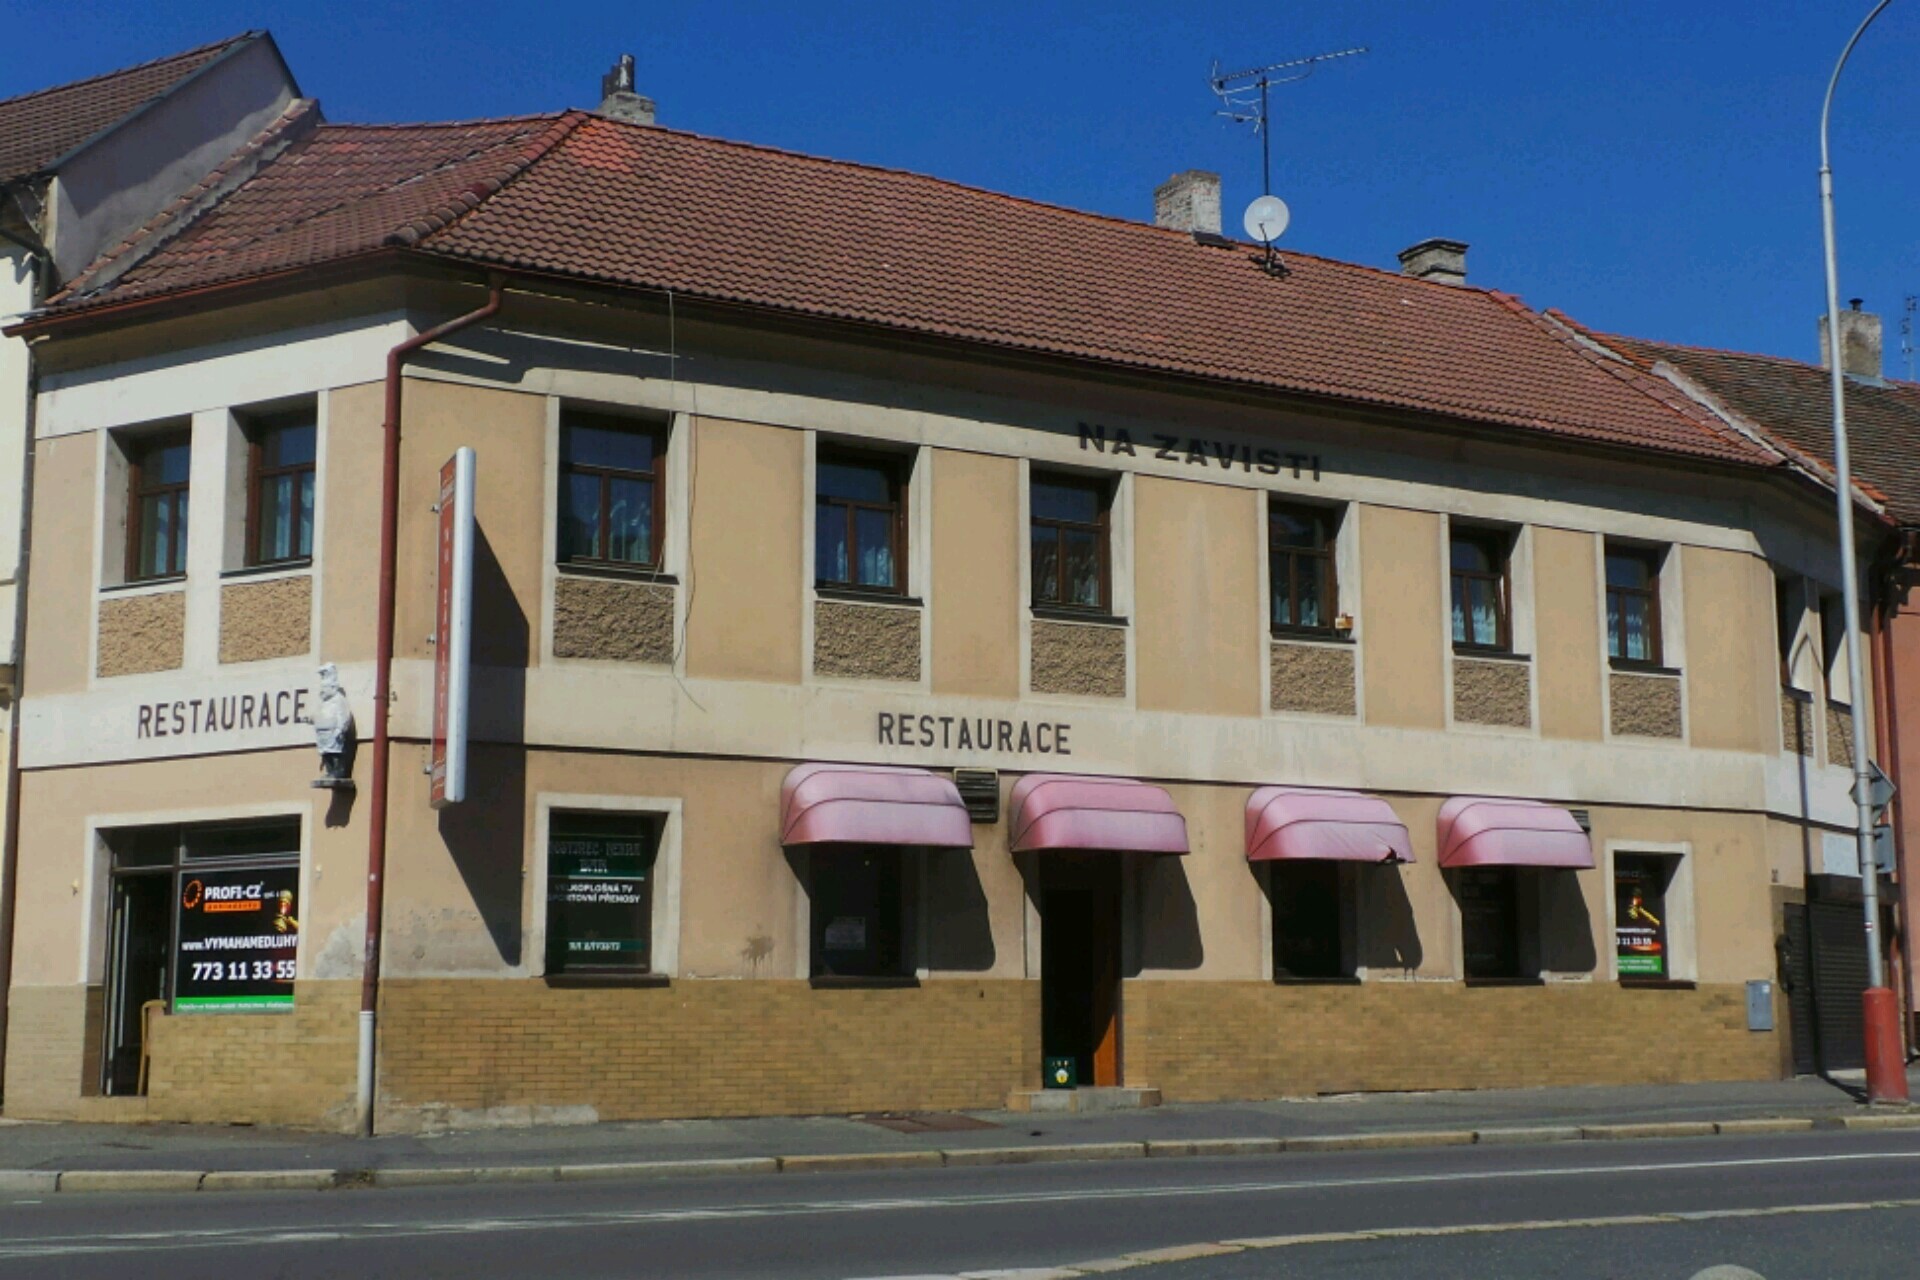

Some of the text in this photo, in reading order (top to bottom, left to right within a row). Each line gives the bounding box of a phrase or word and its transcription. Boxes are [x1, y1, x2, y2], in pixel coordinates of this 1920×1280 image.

[1077, 421, 1137, 457] NA
[138, 688, 309, 739] RESTAURACE
[877, 712, 1072, 755] RESTAURACE
[621, 884, 634, 894] TV
[192, 960, 295, 981] 773 11 33 55
